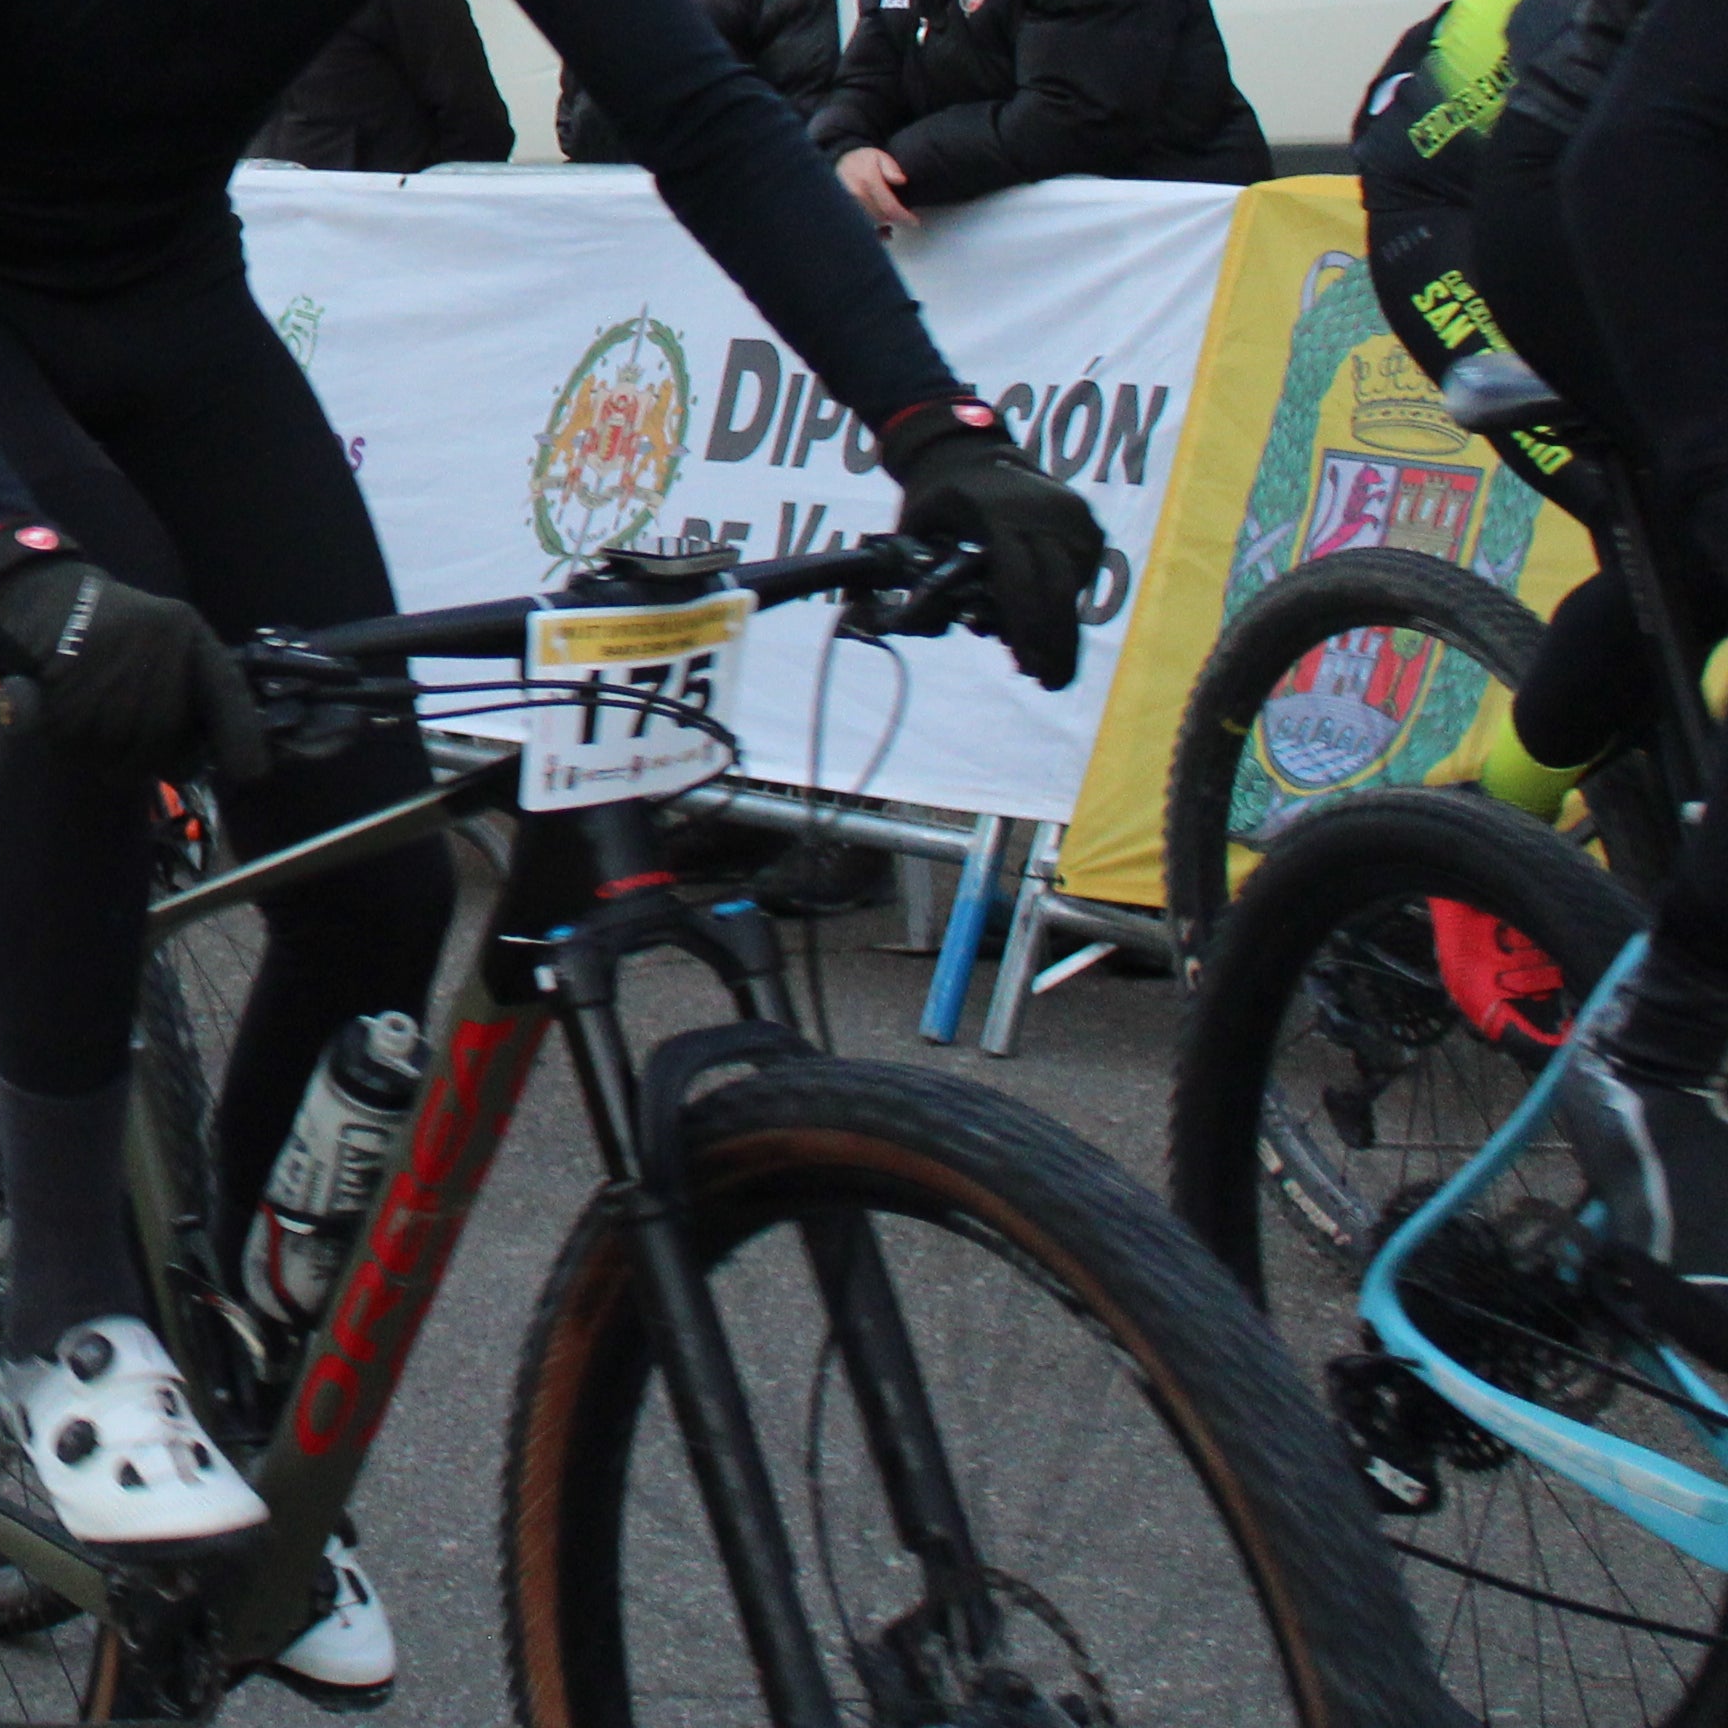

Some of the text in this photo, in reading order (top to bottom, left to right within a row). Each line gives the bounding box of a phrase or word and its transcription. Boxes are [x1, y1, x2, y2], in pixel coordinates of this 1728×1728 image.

[1411, 279, 1477, 350] SAN
[705, 327, 1169, 485] DIPUCIÓN
[579, 651, 714, 745] 175
